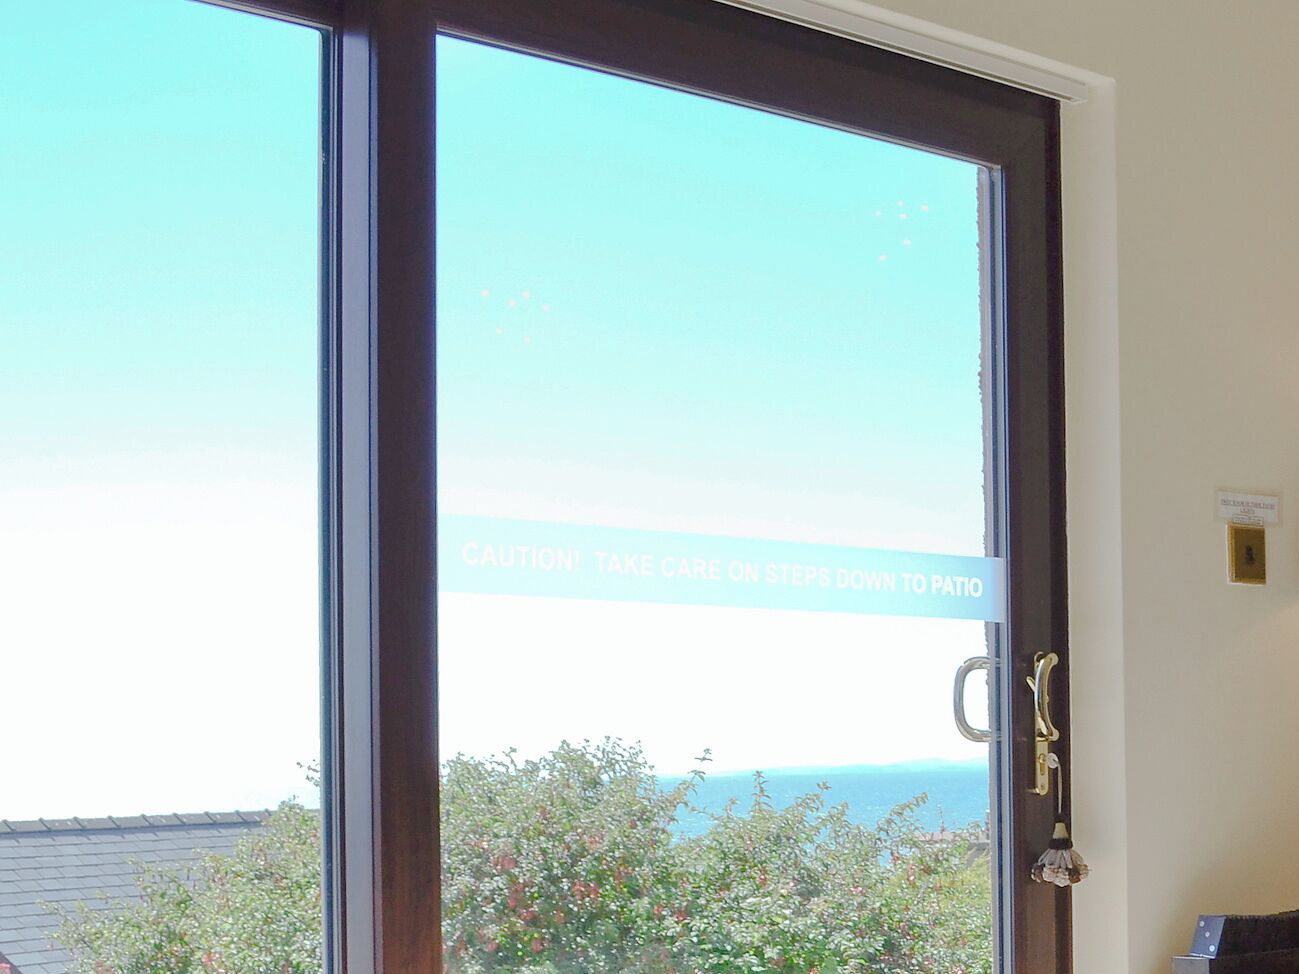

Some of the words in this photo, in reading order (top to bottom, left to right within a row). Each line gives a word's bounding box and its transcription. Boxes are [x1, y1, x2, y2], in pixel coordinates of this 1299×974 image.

[461, 541, 581, 572] CAUTION!
[594, 551, 654, 577] TAKE
[661, 555, 722, 581] CARE
[728, 561, 759, 584] ON
[765, 563, 832, 588] STEPS
[837, 567, 897, 593] DOWN
[901, 572, 928, 595] TO
[930, 575, 984, 598] PATIO
